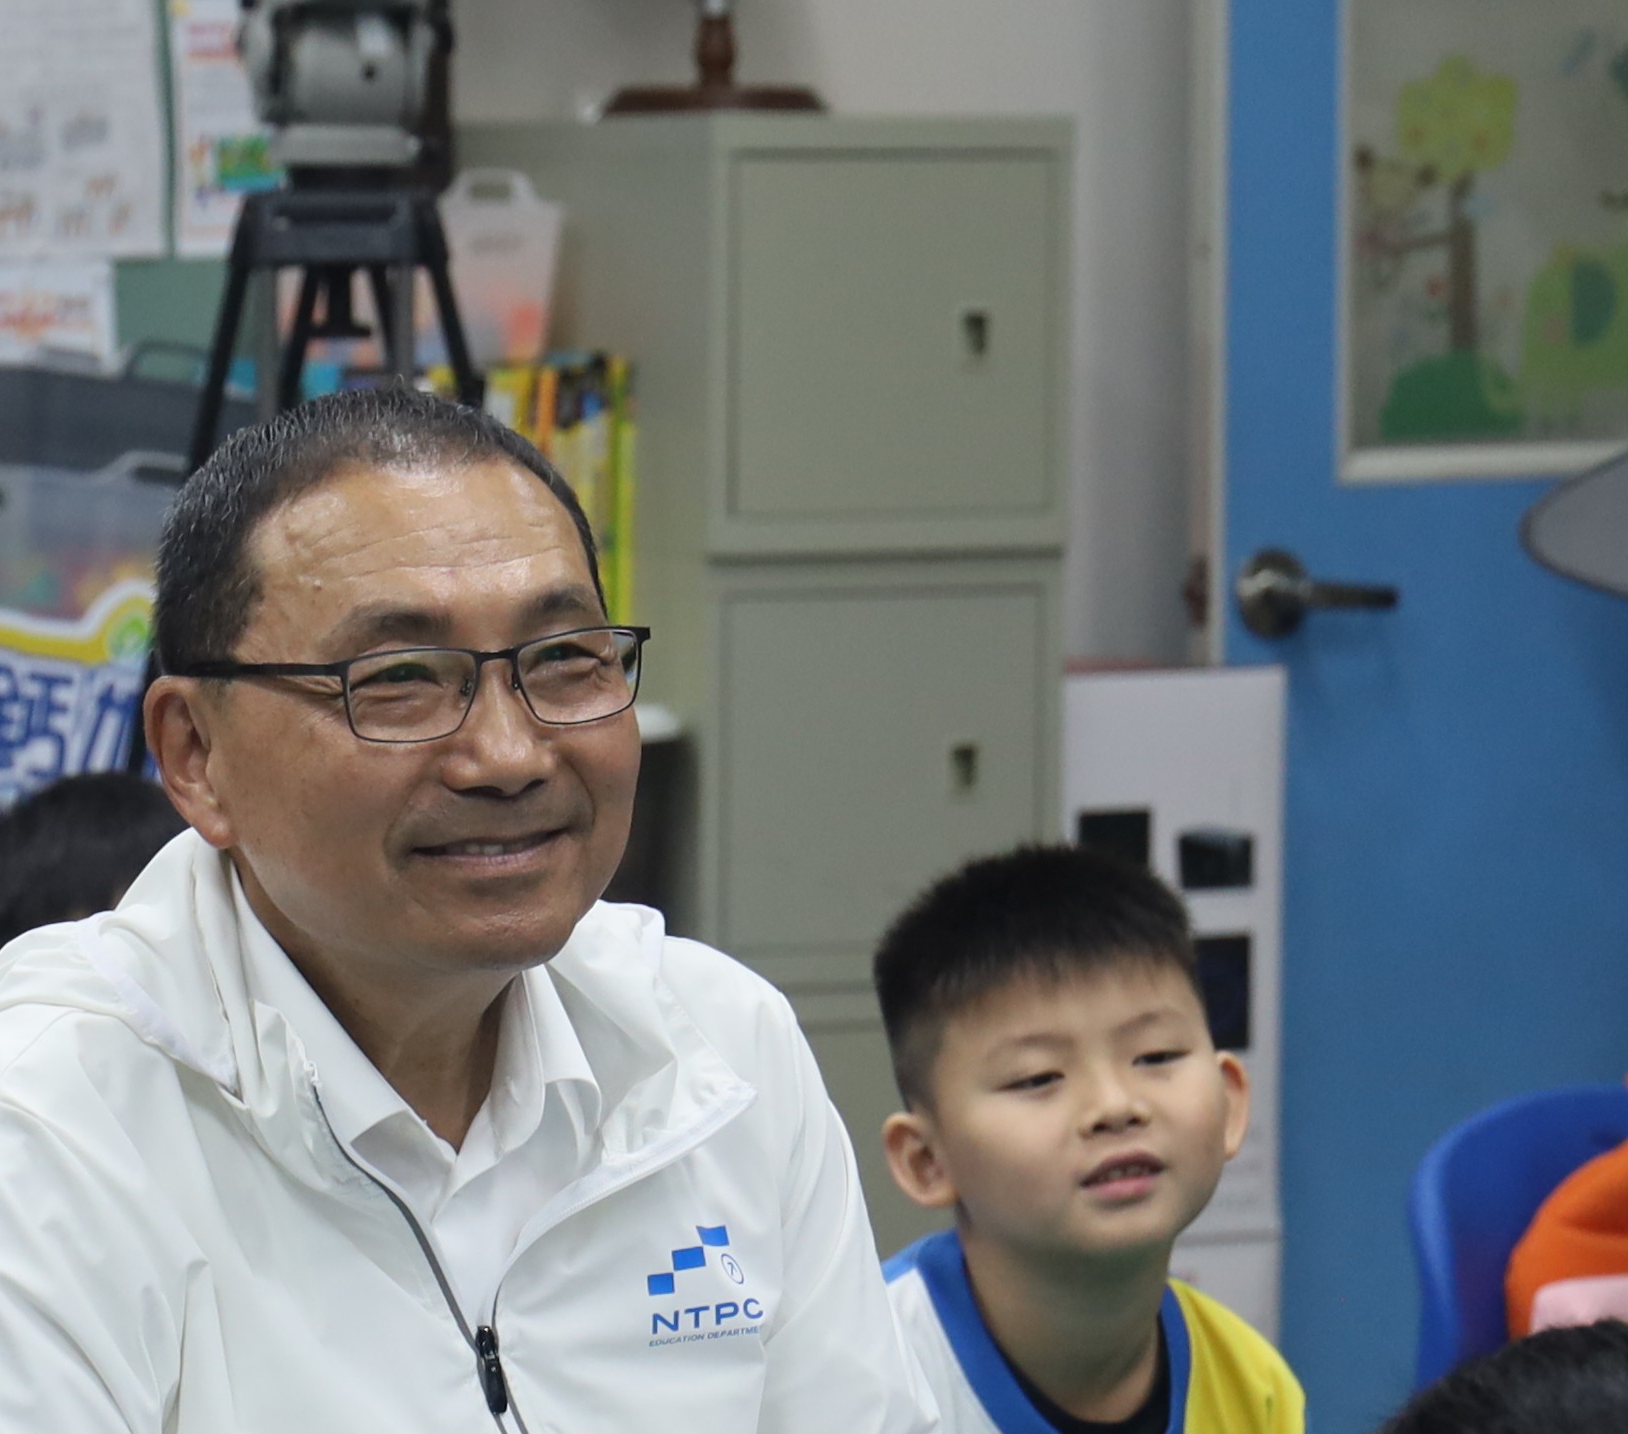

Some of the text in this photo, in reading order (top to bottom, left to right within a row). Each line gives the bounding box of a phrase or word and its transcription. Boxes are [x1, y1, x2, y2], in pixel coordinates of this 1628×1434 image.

[652, 1298, 764, 1335] NTPC
[648, 1325, 759, 1347] EDUCATION DEPARTME
